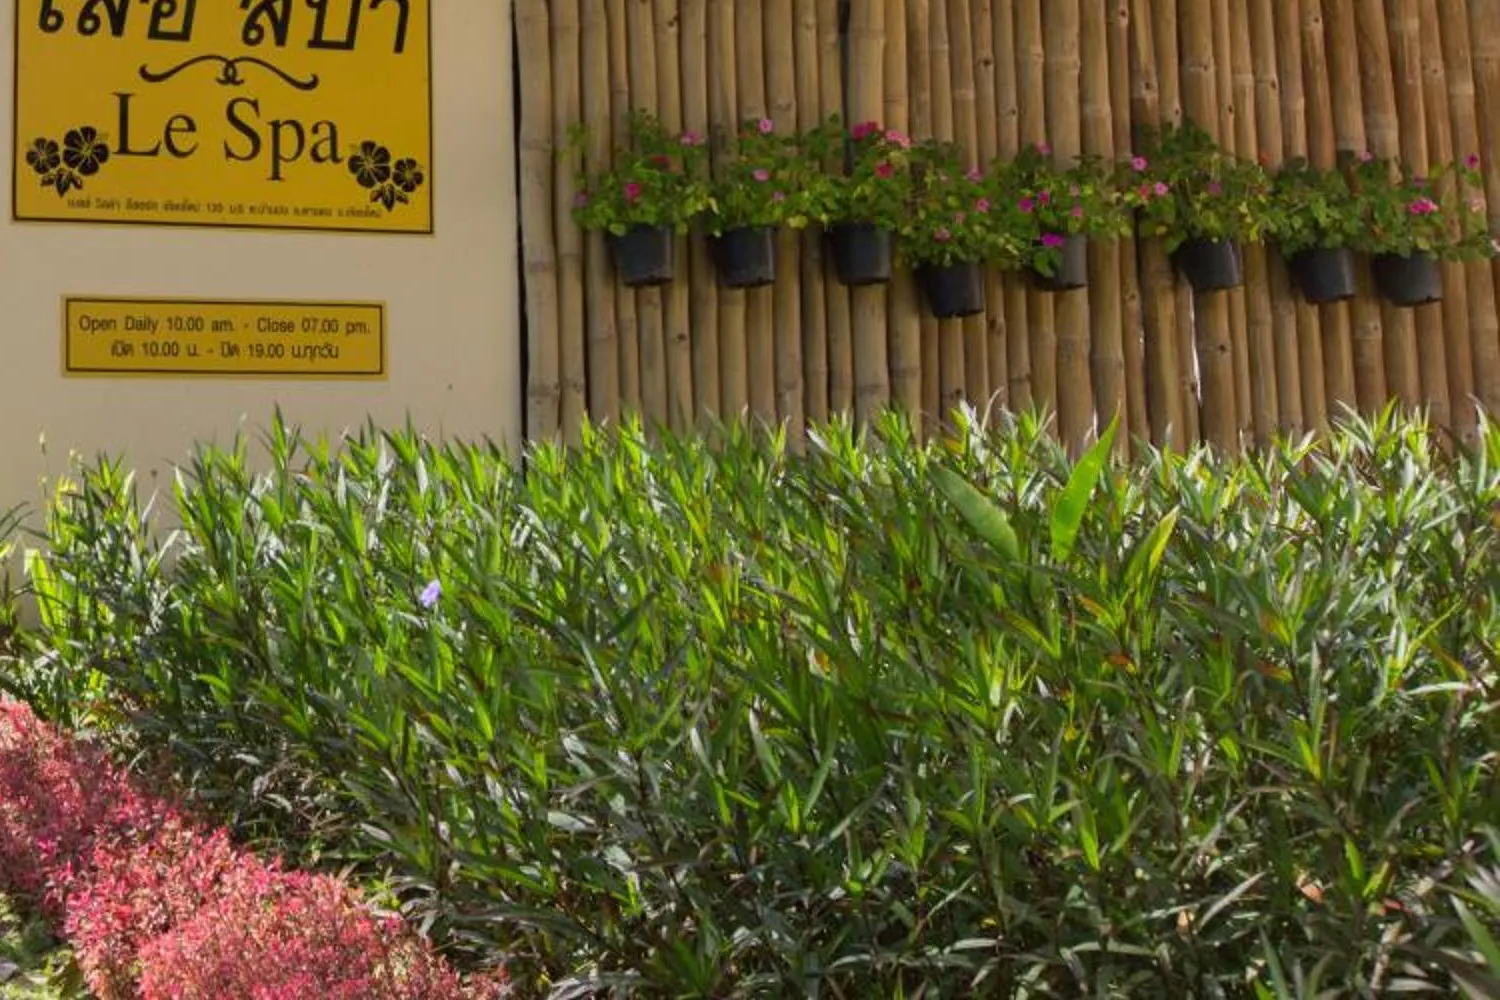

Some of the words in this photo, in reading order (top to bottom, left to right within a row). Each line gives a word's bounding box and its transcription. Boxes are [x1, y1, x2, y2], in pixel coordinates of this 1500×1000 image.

[111, 92, 199, 159] Le
[223, 96, 343, 182] Spa
[78, 315, 116, 334] Open
[125, 315, 159, 334] Daily
[167, 316, 204, 332] 10.00
[257, 316, 295, 333] Close
[301, 317, 339, 333] 07.00
[346, 320, 371, 335] pm.
[142, 341, 180, 357] 10.00
[249, 342, 285, 358] 19.00
